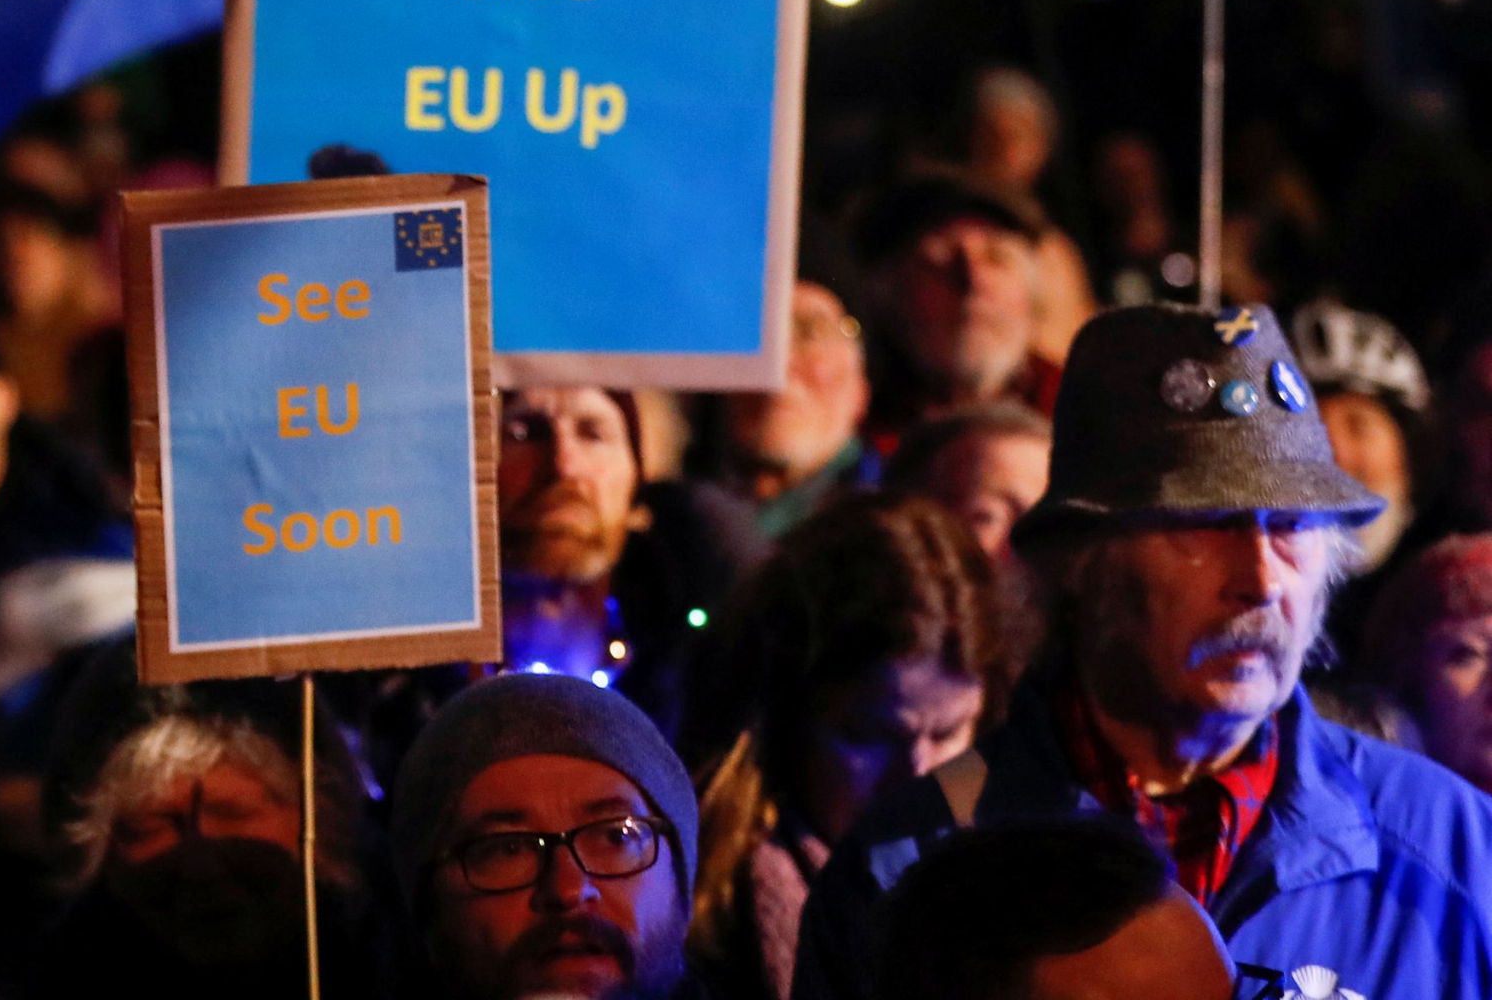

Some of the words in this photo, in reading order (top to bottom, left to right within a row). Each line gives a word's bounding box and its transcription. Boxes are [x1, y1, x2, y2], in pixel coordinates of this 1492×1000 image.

[403, 65, 504, 133] EU
[524, 67, 628, 150] Up
[256, 272, 372, 327] See
[276, 381, 361, 440] EU
[242, 502, 403, 557] Soon
